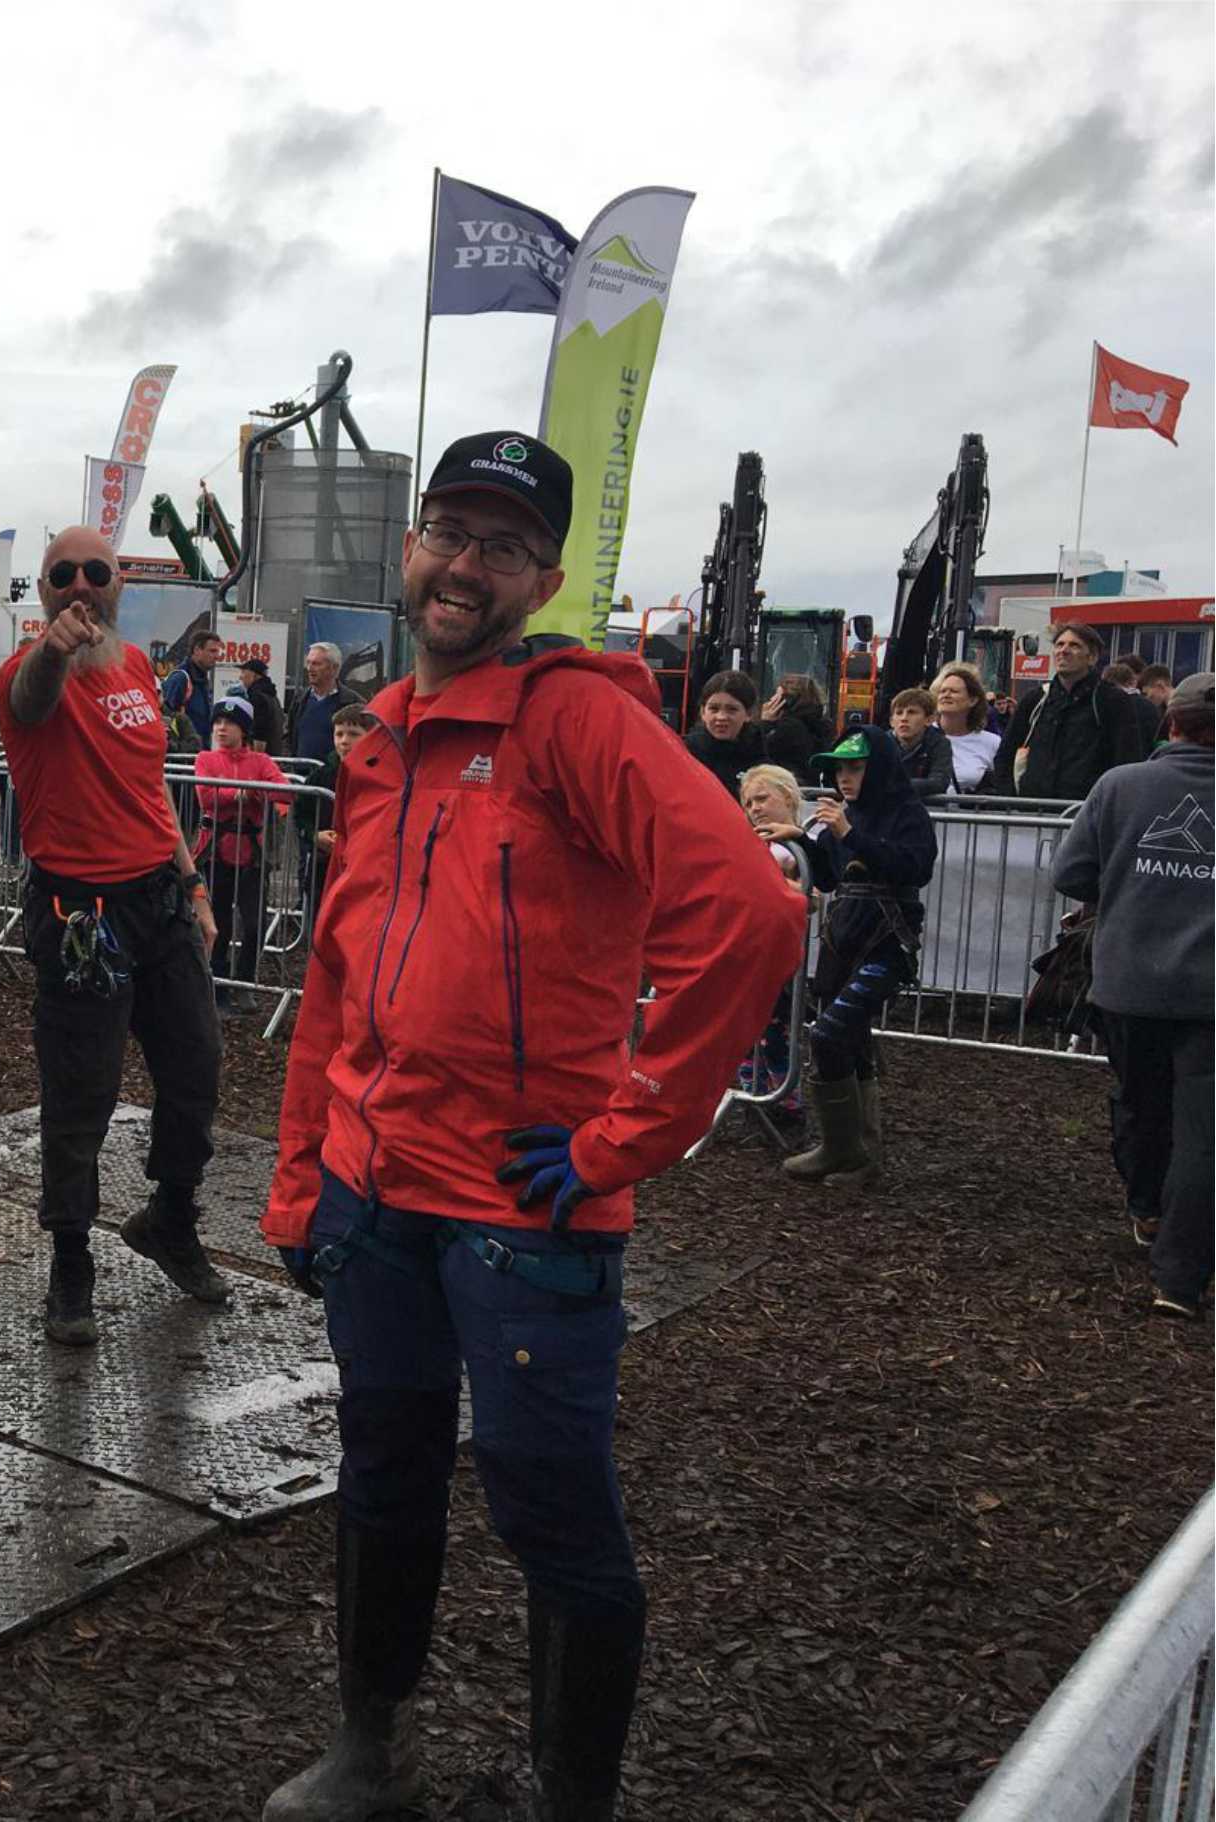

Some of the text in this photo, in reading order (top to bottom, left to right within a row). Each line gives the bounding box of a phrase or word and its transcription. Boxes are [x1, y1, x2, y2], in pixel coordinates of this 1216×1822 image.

[458, 220, 573, 263] VOLV
[454, 245, 565, 288] PENT
[590, 262, 668, 293] Mountaineering
[588, 277, 625, 295] Ireland
[220, 641, 271, 664] ROSS
[107, 704, 157, 730] CREW
